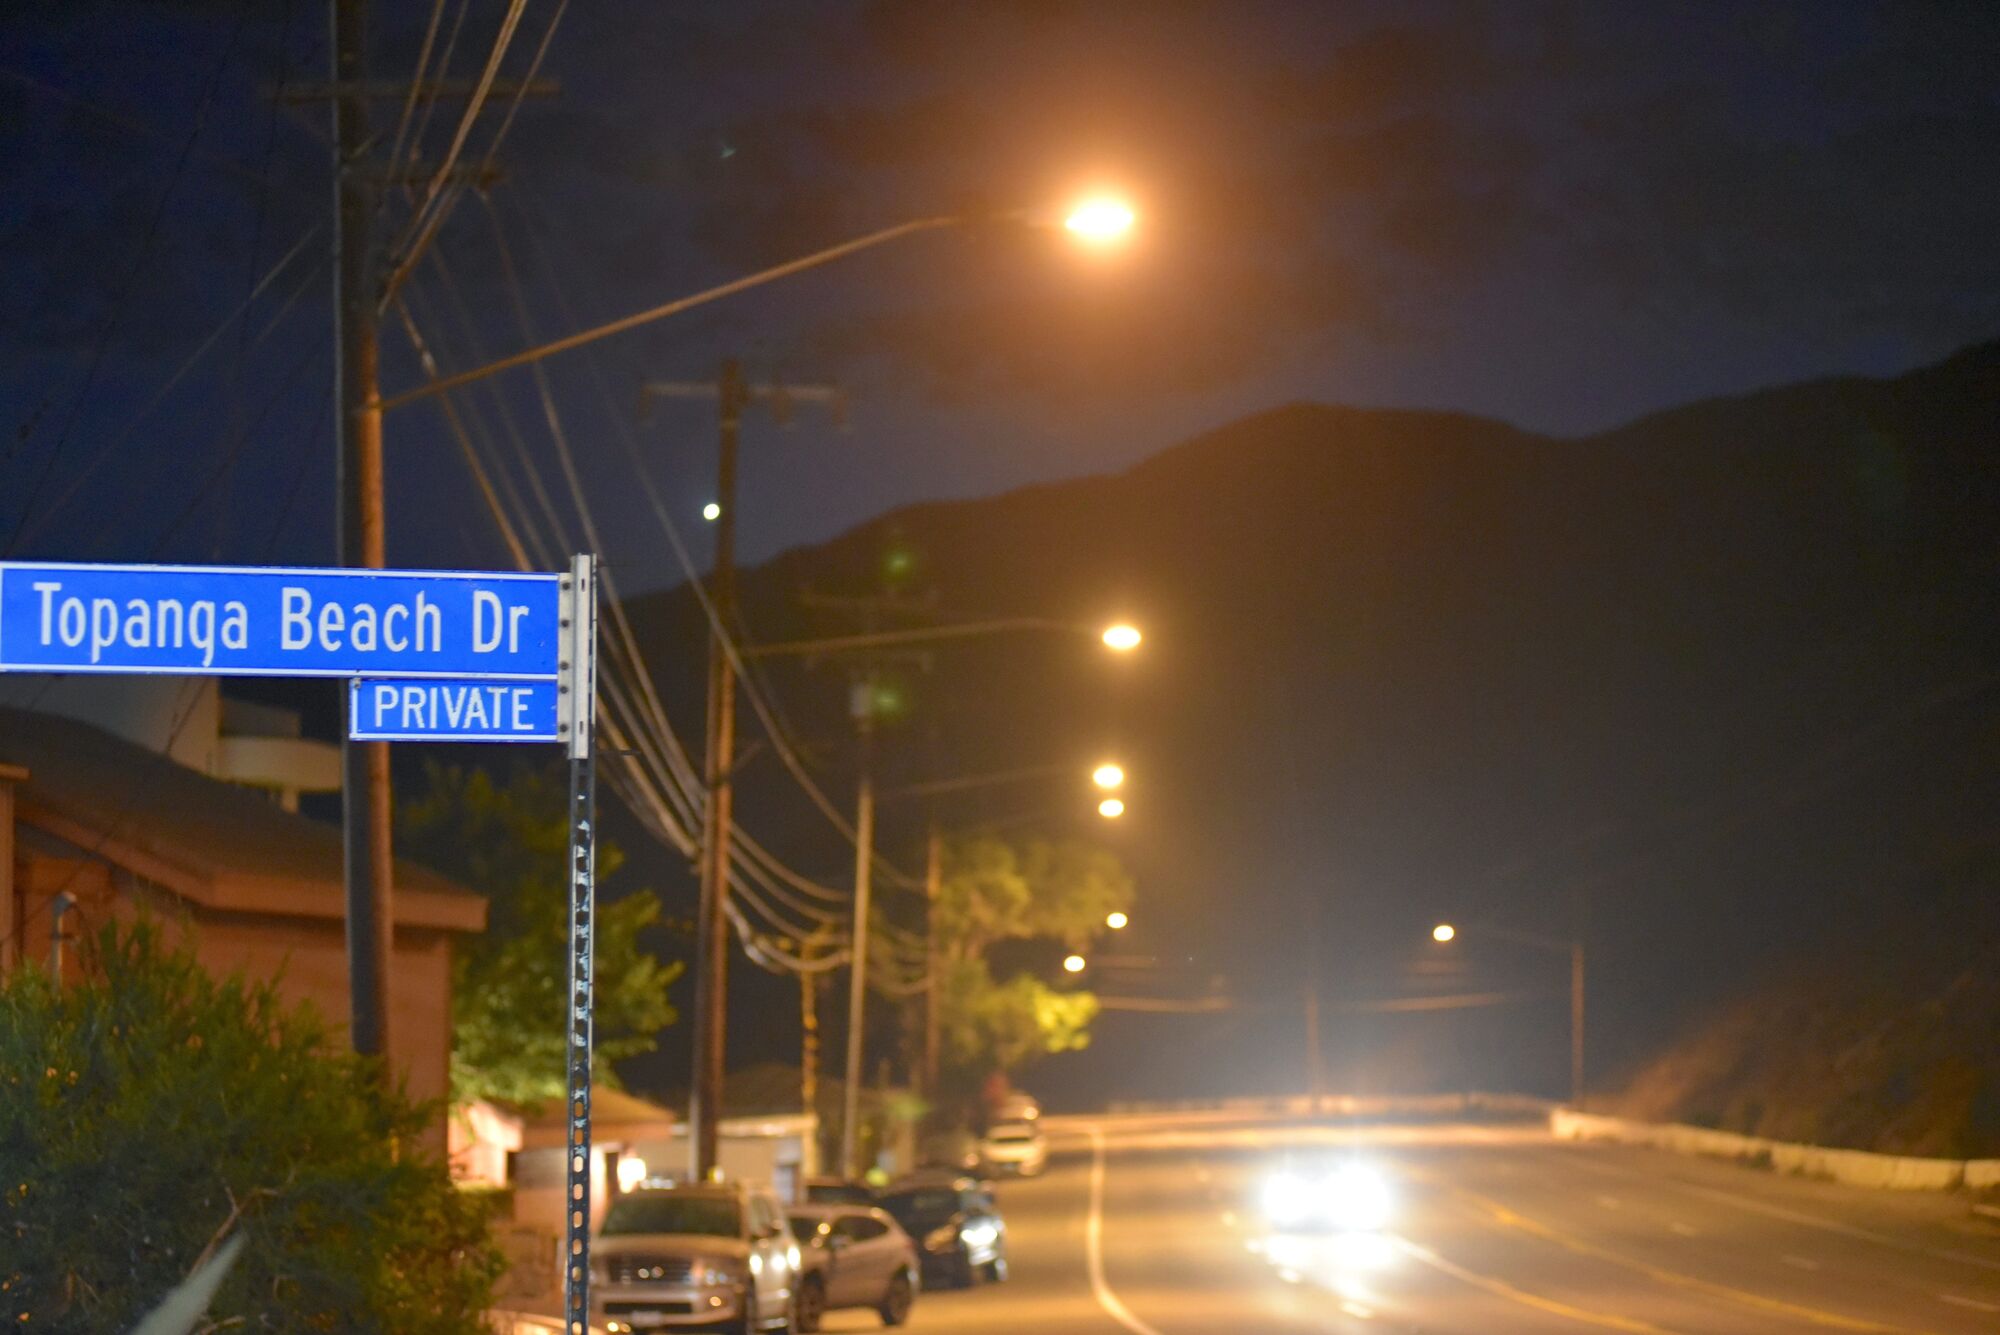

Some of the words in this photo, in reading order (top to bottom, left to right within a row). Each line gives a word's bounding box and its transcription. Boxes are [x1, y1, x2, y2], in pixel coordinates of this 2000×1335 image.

[33, 582, 248, 667] Topanga
[281, 587, 442, 651] Beach
[472, 590, 529, 654] Dr
[374, 686, 534, 730] PRIVATE
